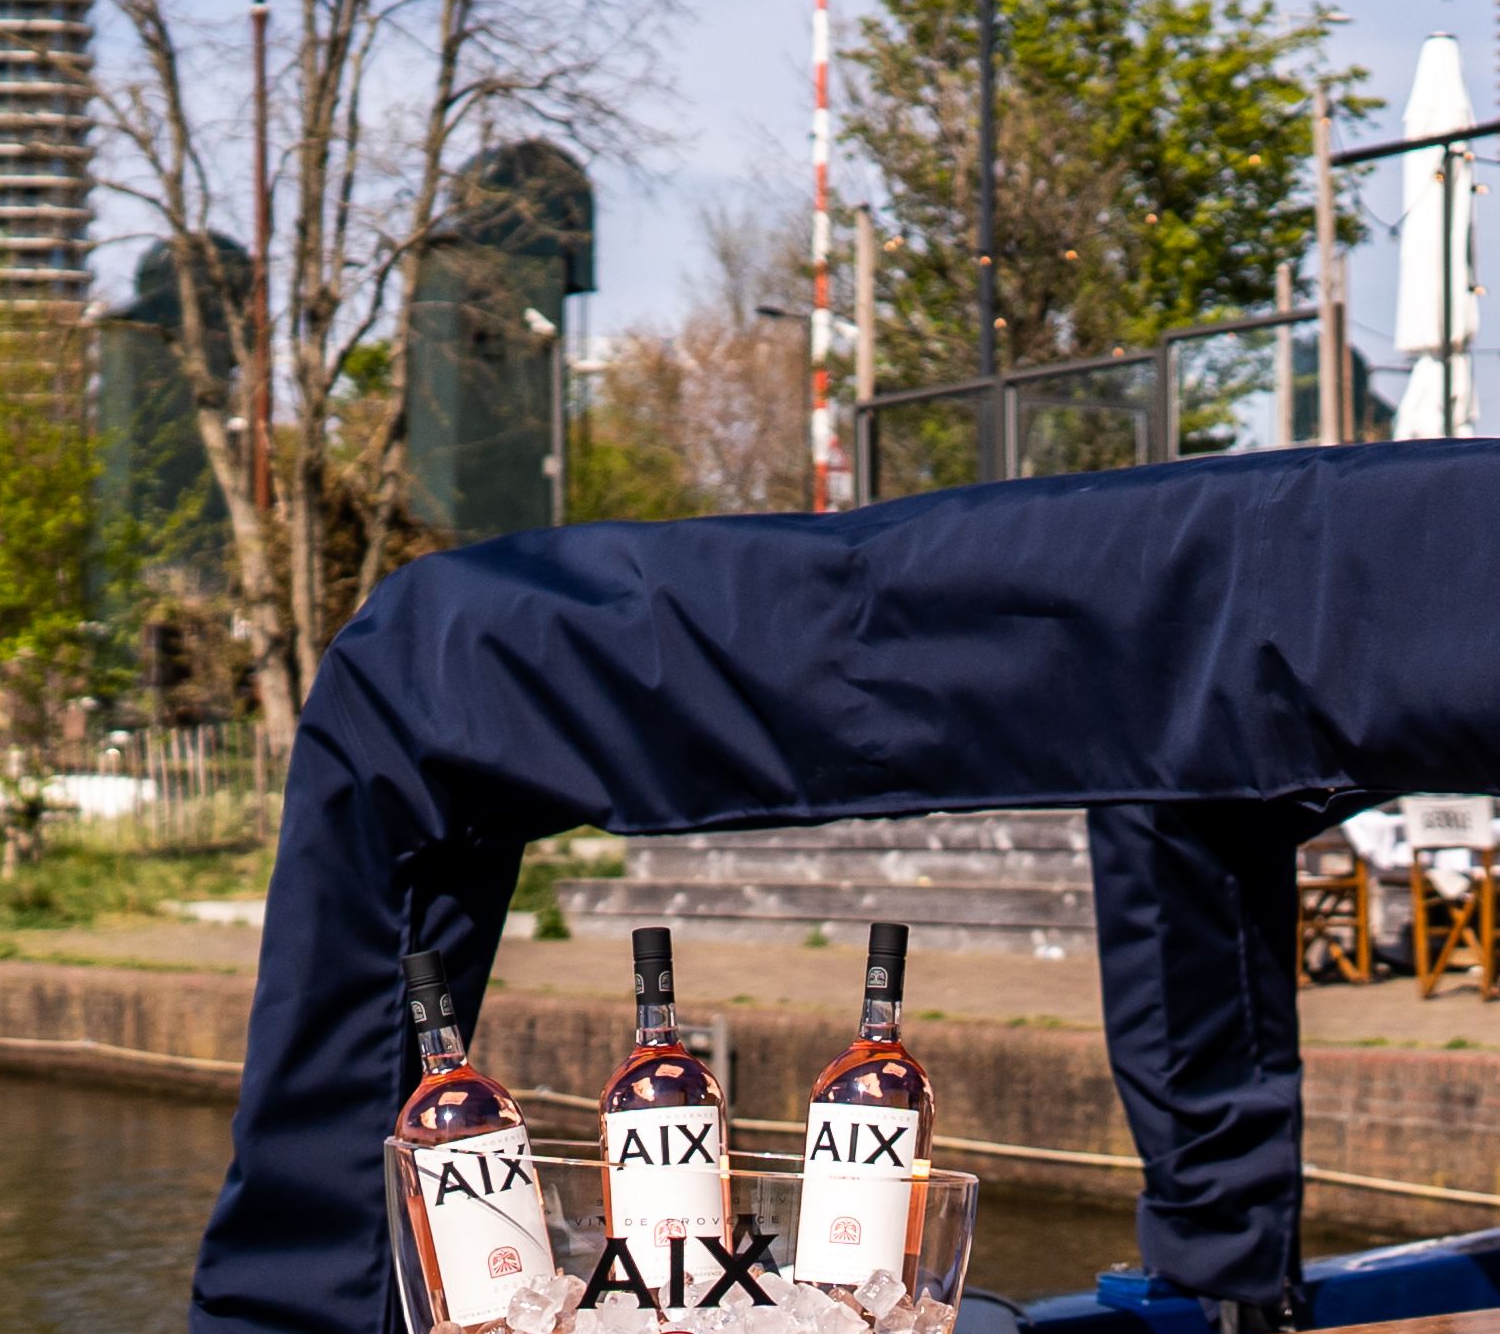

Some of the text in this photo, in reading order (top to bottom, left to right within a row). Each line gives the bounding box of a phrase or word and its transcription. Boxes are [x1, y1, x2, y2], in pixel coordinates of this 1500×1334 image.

[616, 1123, 715, 1171] AIX
[810, 1121, 909, 1168] AIX
[434, 1143, 534, 1207] AIX
[624, 1218, 648, 1226] DE
[575, 1234, 780, 1310] AIX
